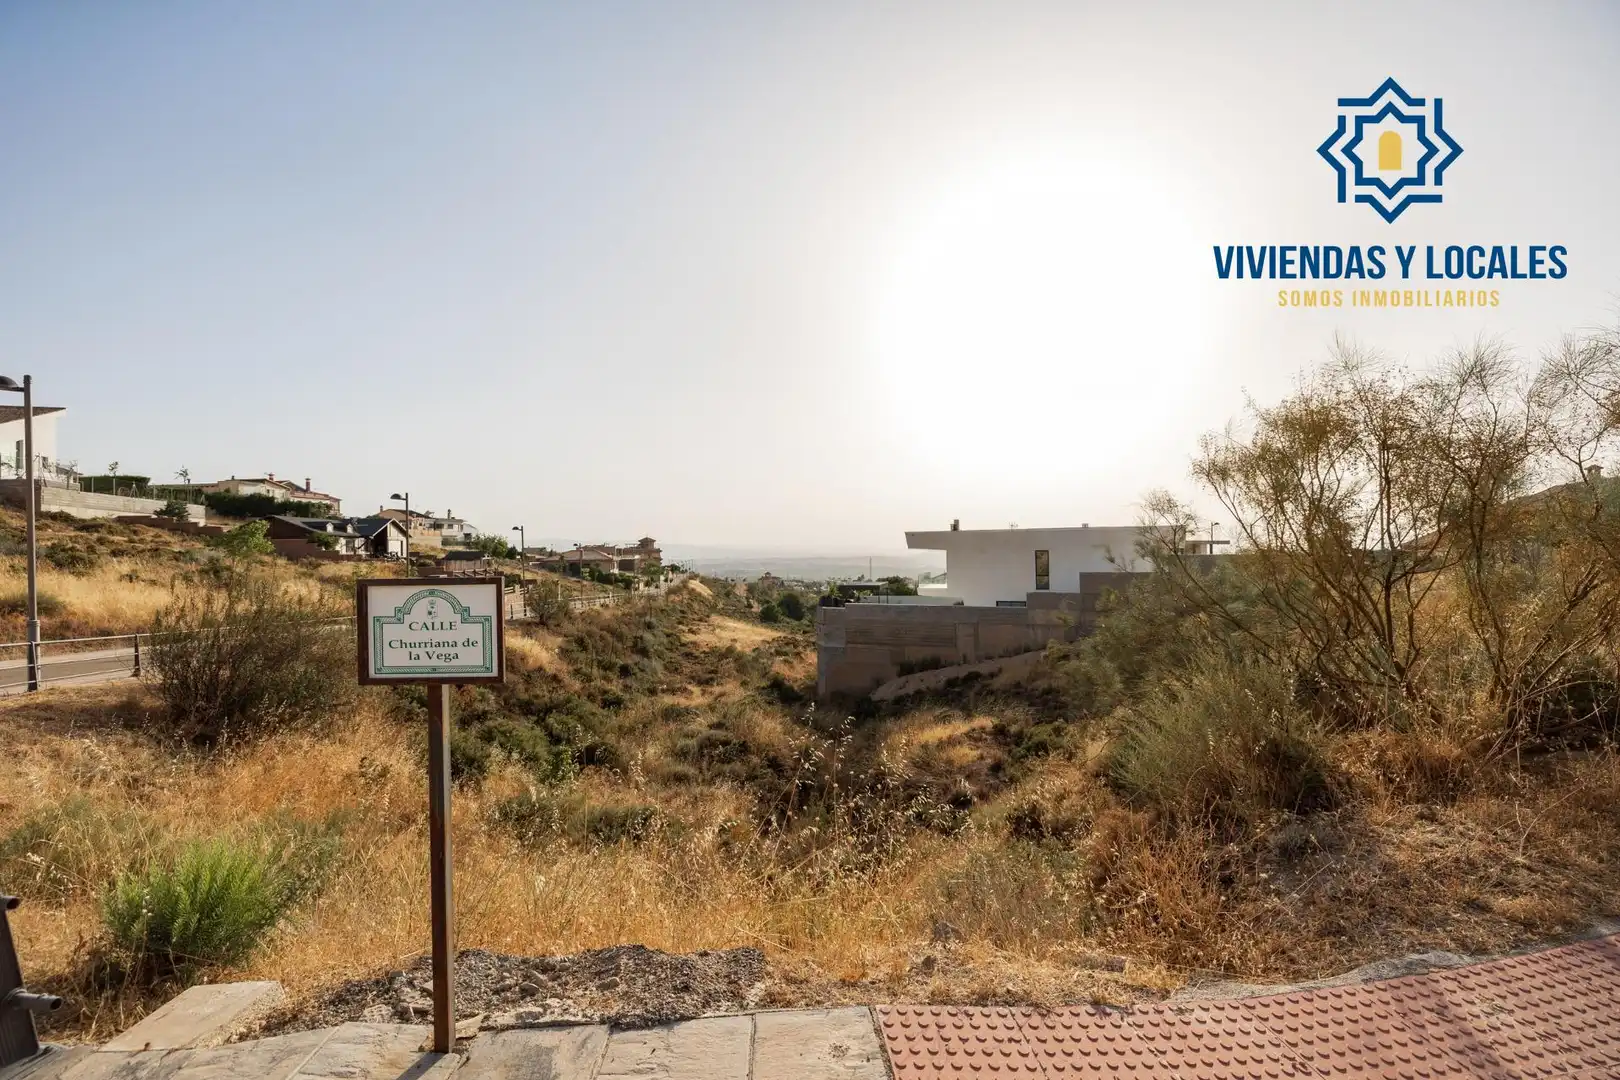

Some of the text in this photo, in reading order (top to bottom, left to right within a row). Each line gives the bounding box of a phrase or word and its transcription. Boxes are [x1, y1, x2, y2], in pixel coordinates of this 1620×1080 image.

[408, 621, 458, 631] CALLE
[388, 638, 479, 649] Churriana de
[408, 651, 460, 663] la Vega
